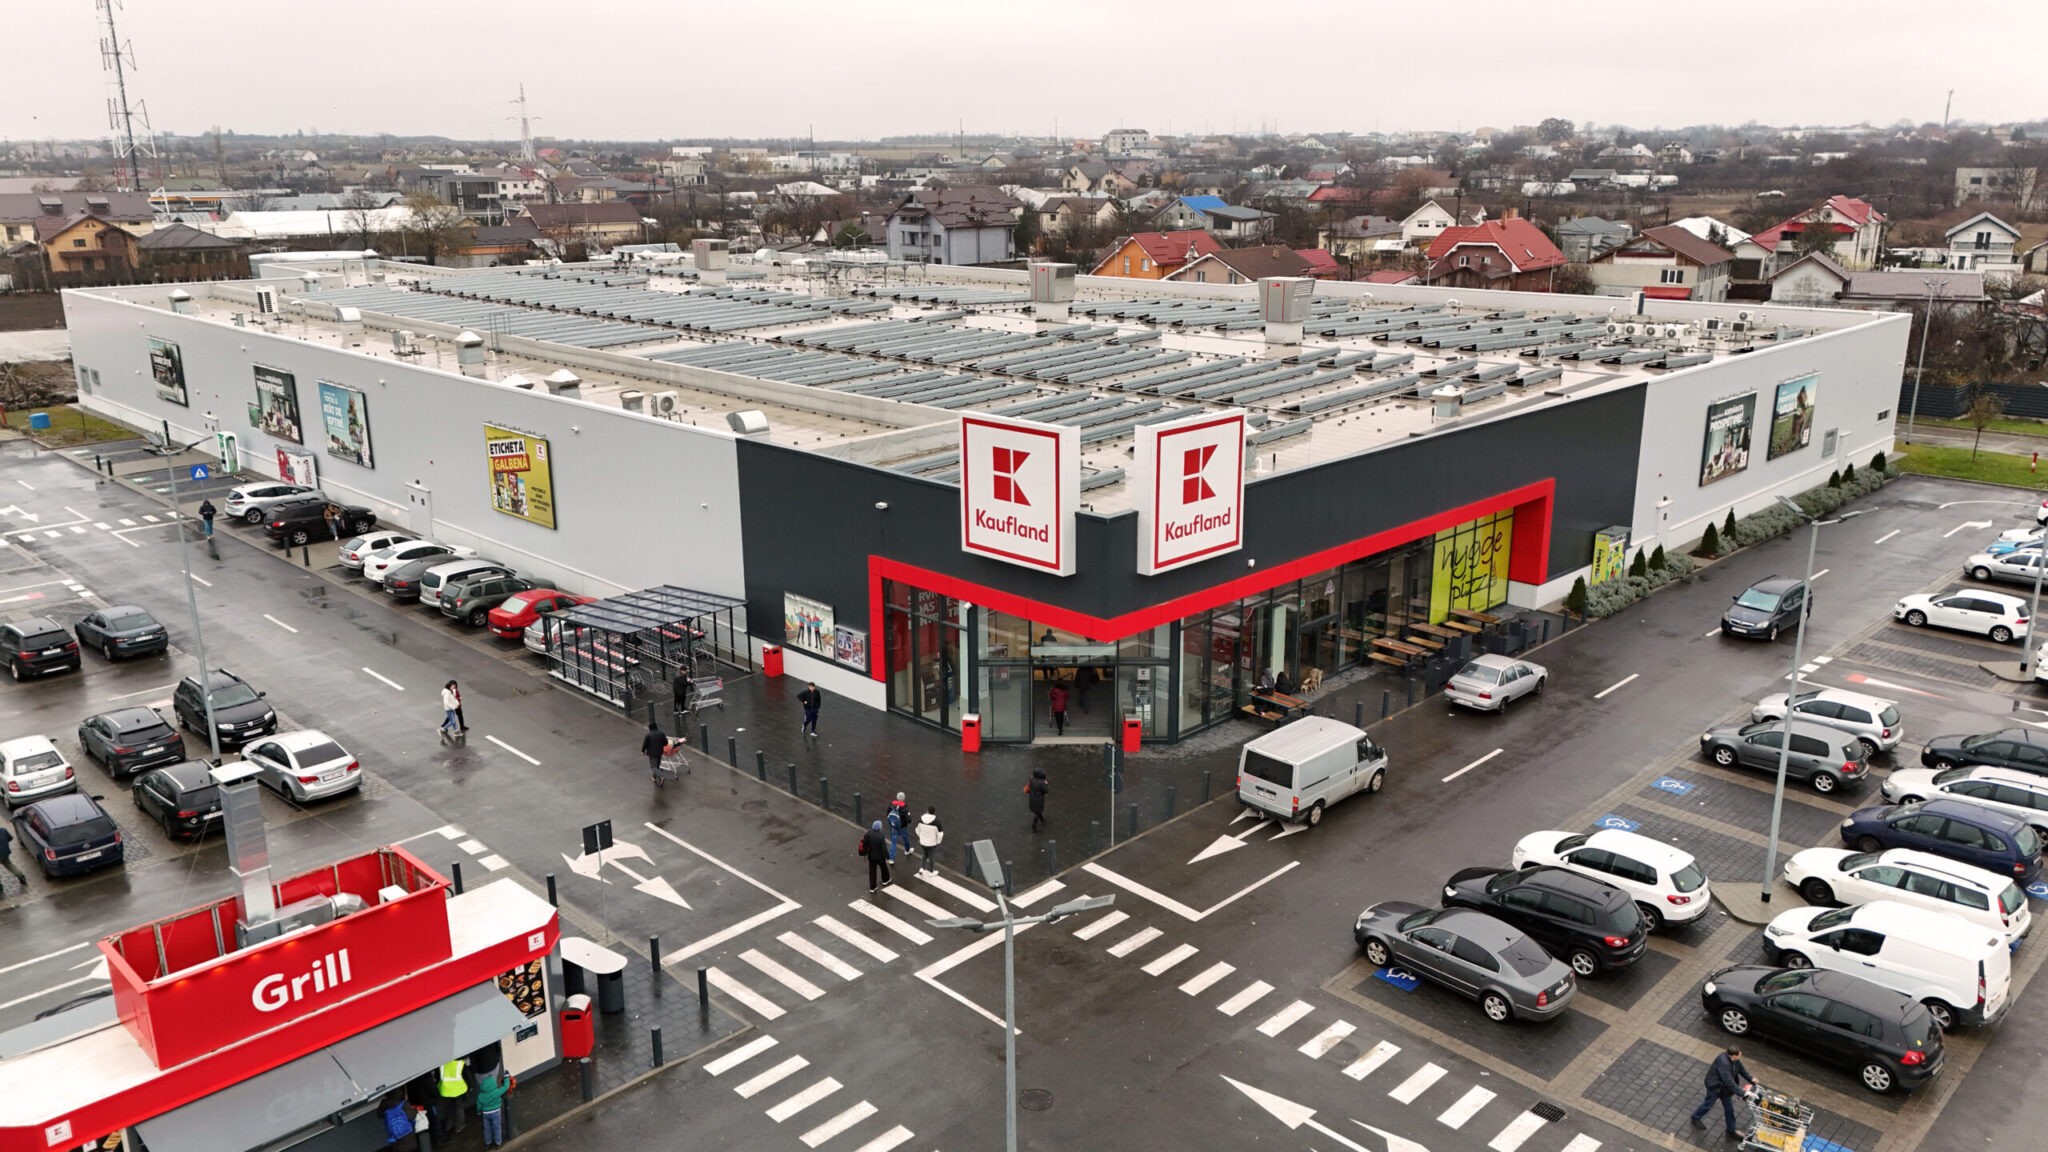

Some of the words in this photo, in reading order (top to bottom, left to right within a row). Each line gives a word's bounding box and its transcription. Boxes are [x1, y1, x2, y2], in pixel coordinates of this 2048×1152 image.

[489, 440, 524, 455] ETICHETA
[494, 454, 528, 471] GALBENĂ
[975, 508, 1049, 544] Kaufland
[1165, 507, 1231, 542] Kaufland
[1442, 531, 1502, 580] hygge
[252, 948, 352, 1012] Grill
